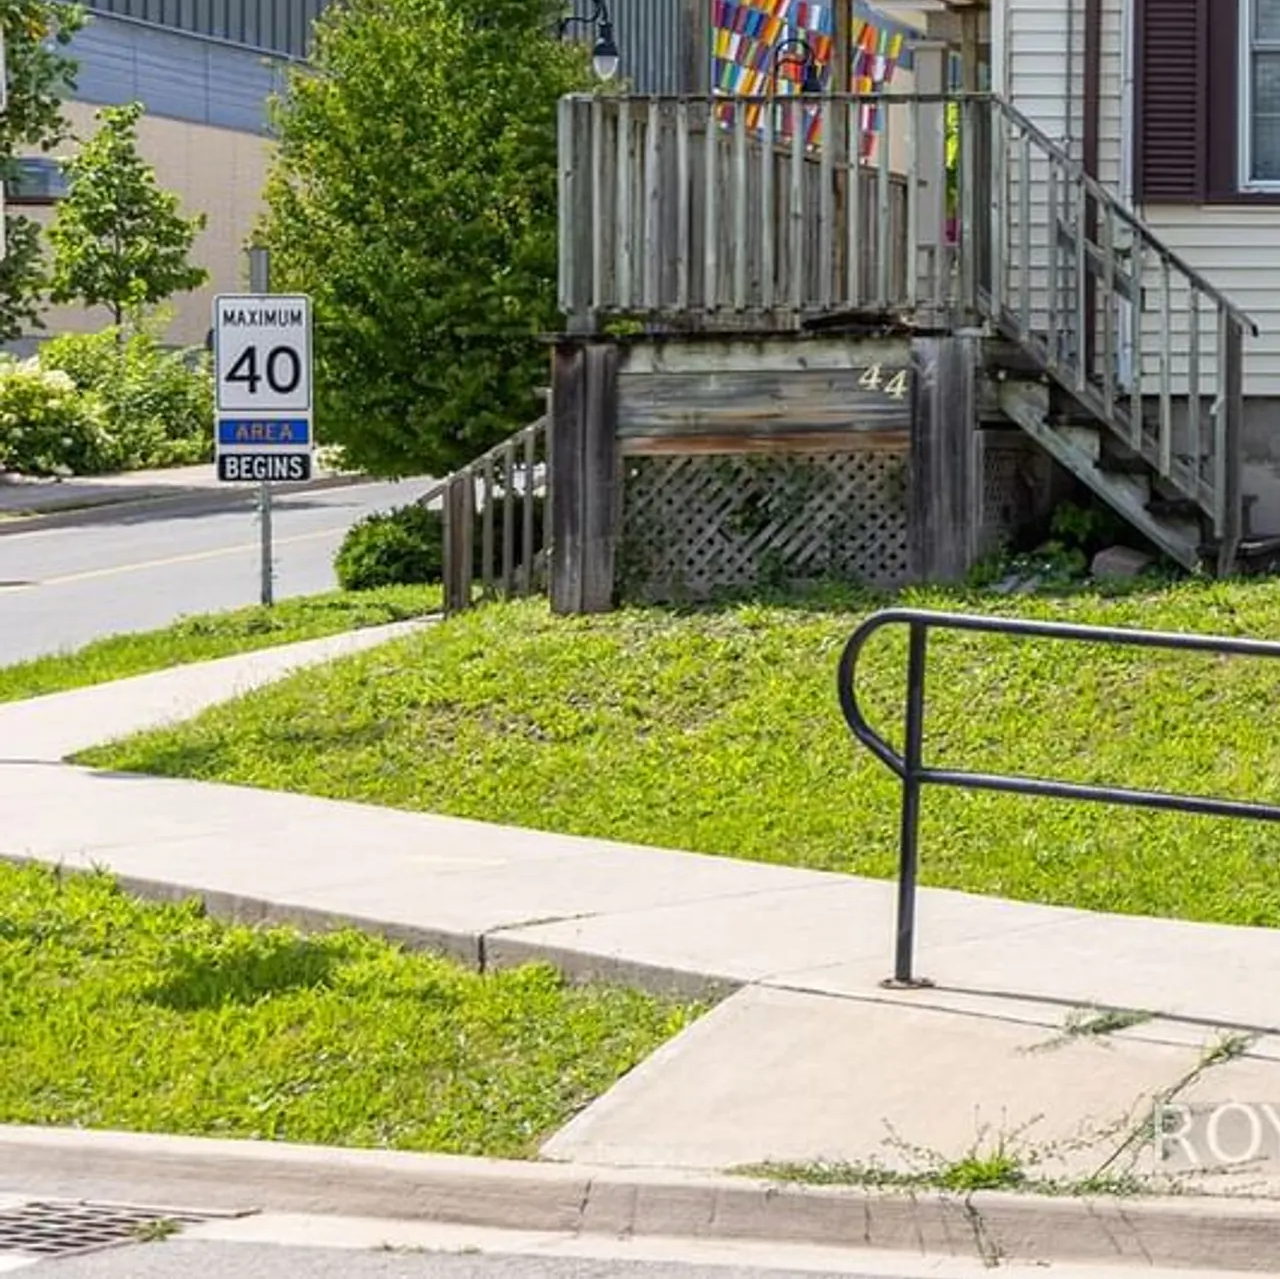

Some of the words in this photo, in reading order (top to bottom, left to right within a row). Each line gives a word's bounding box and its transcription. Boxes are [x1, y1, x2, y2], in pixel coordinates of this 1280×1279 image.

[223, 308, 303, 327] MAXIMUM
[224, 344, 301, 394] 40
[858, 362, 907, 400] 44
[236, 423, 294, 441] AREA
[225, 456, 303, 479] BEGINS
